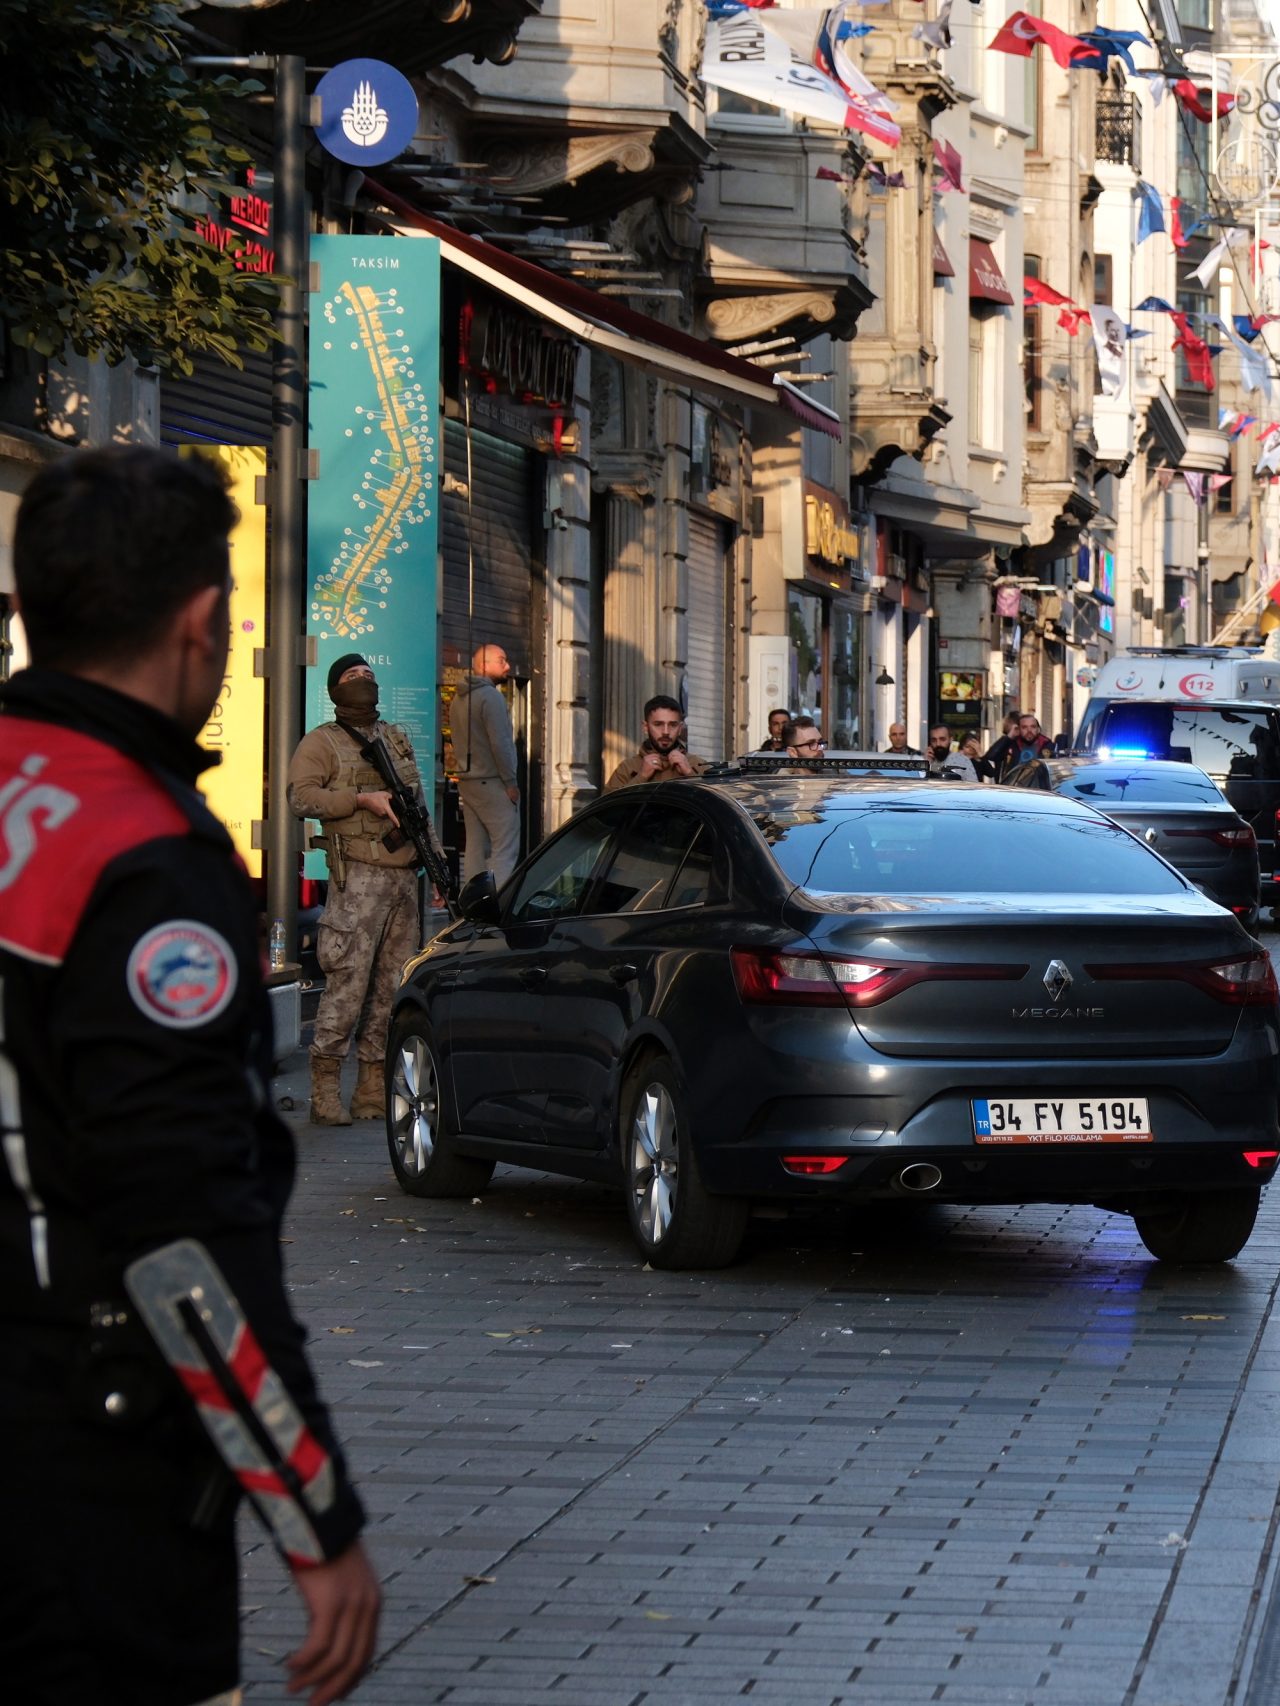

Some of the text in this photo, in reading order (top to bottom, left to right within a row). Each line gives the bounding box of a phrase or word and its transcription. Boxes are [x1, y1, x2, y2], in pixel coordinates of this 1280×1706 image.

[352, 256, 399, 268] TAKSİM
[1188, 681, 1214, 691] 112
[1012, 1008, 1105, 1018] MEGANE
[977, 1102, 1142, 1131] TR 34 FY 5194
